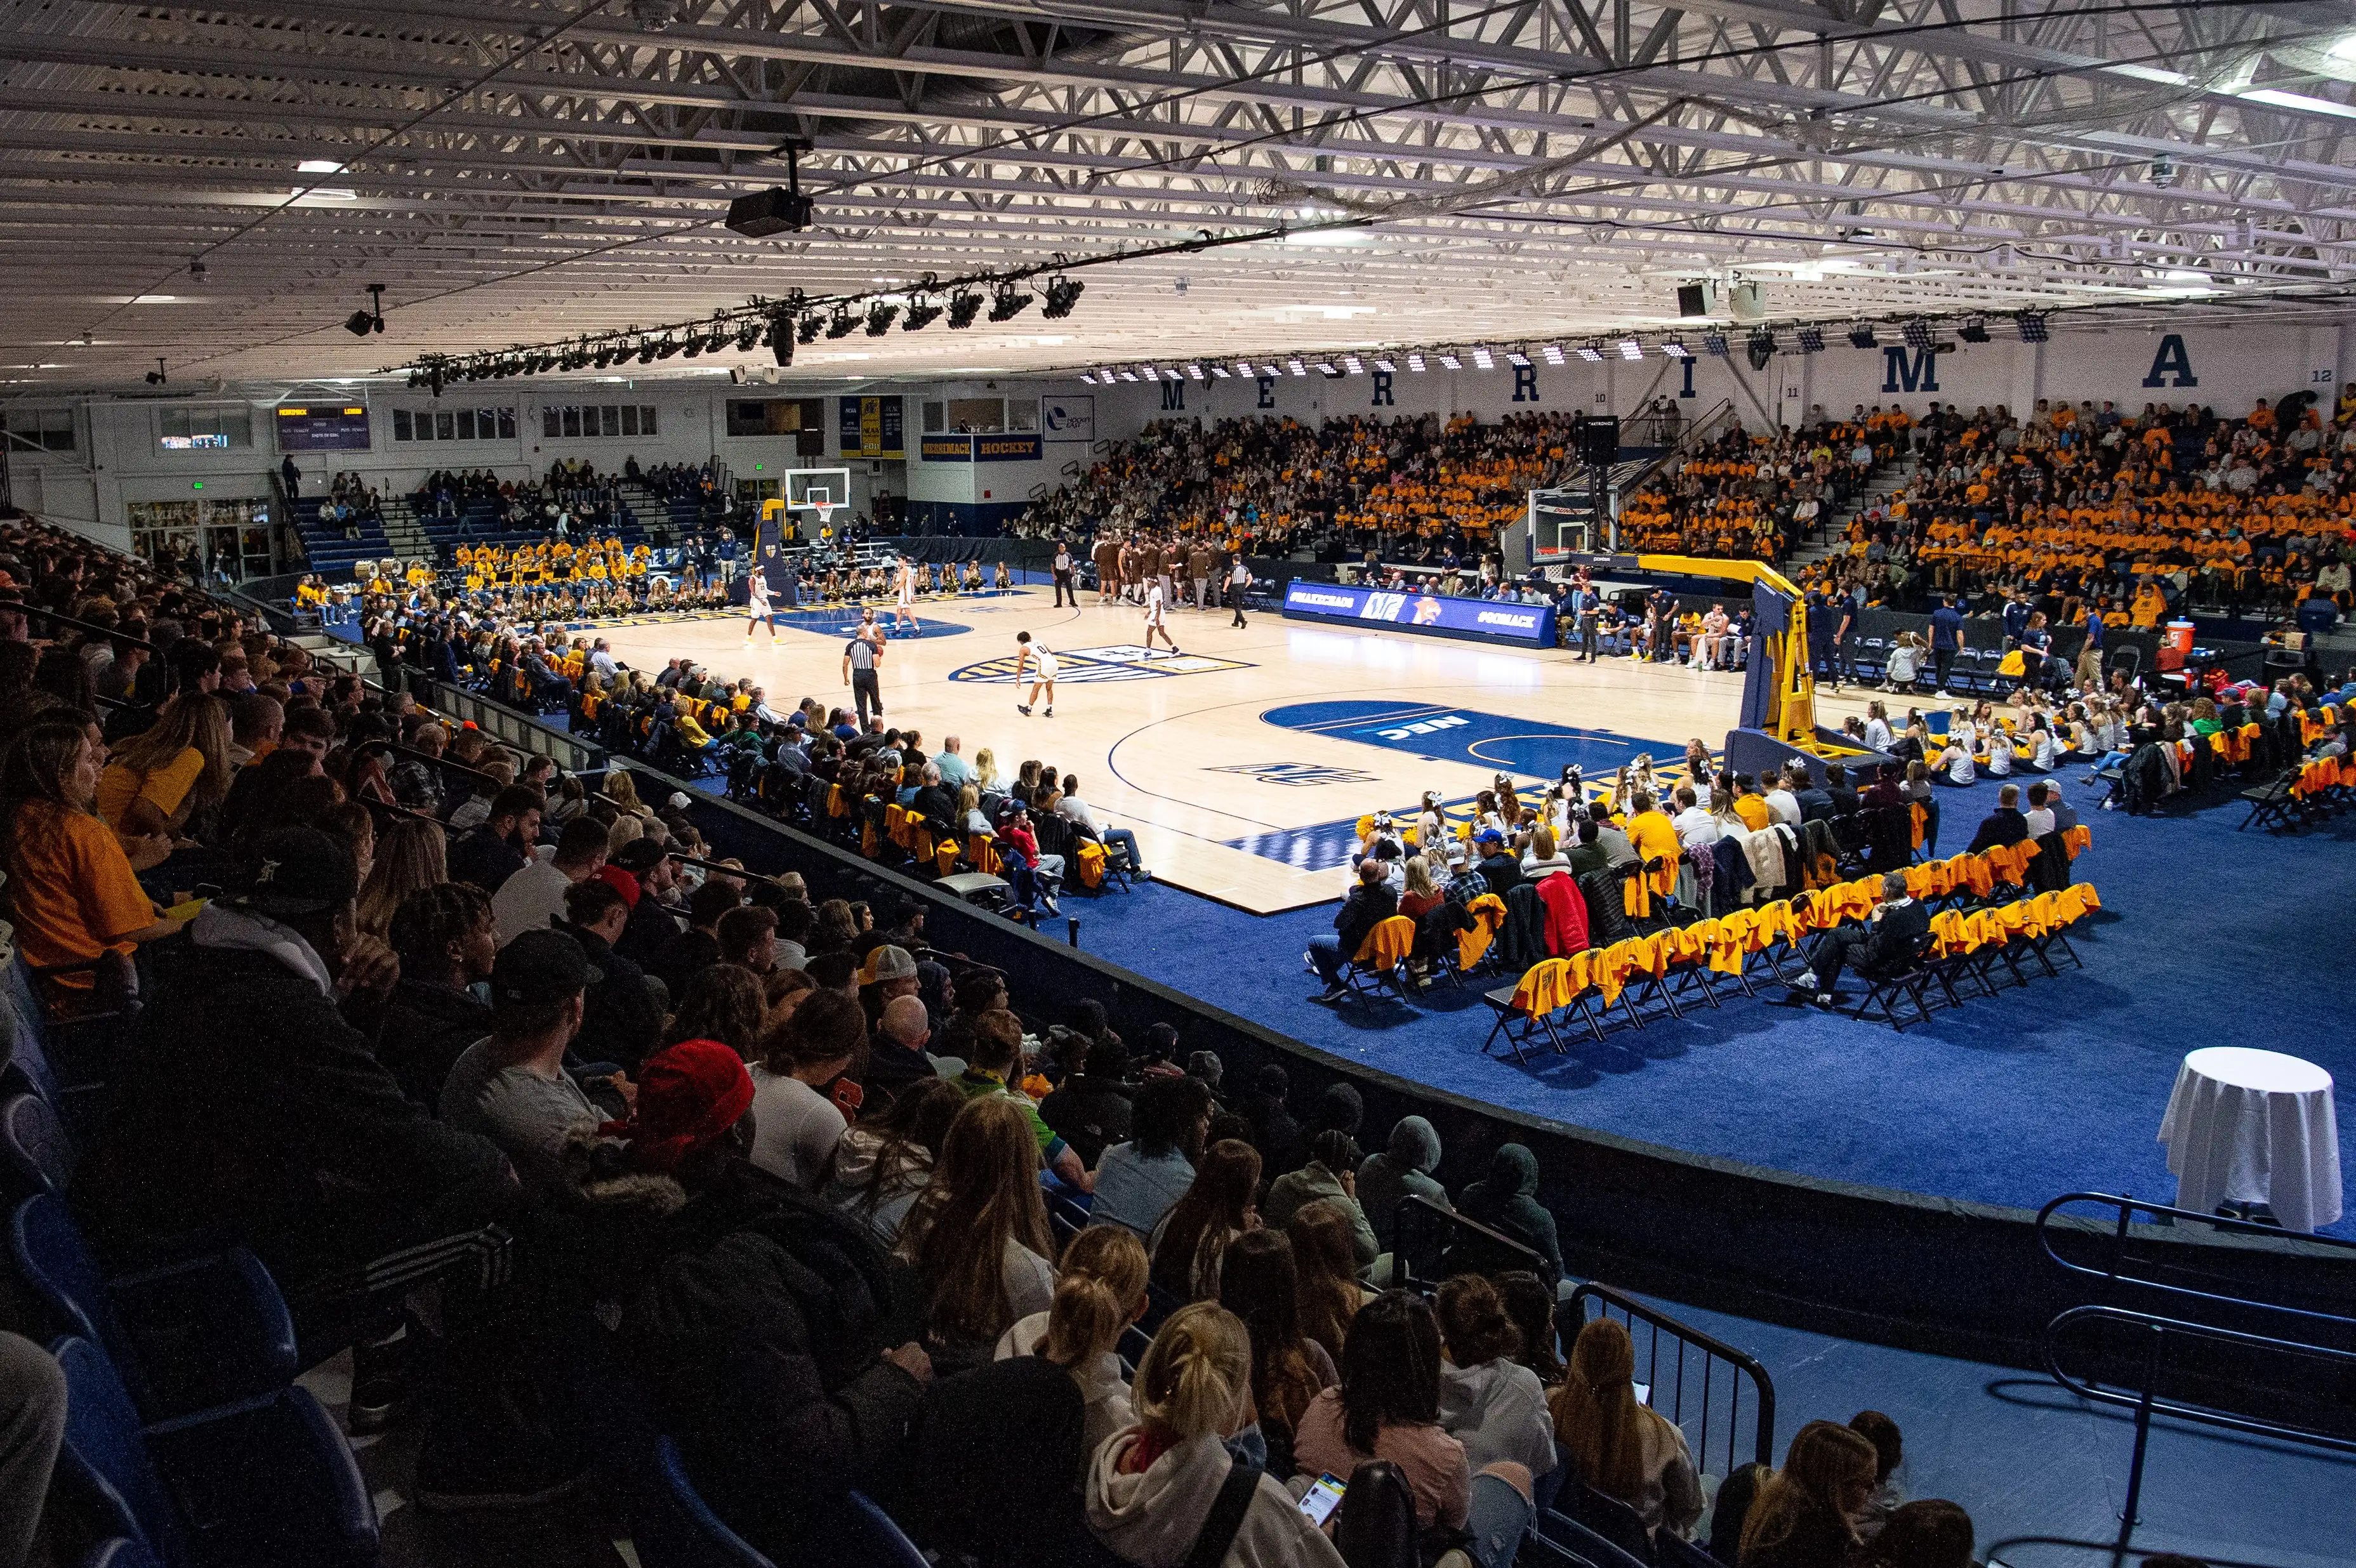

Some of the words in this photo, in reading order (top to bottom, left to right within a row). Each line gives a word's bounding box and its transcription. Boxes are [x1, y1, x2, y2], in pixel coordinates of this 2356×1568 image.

[1160, 379, 1185, 410] M
[1257, 376, 1274, 409] E
[1372, 371, 1394, 405] R
[1512, 364, 1540, 402] R
[1679, 356, 1697, 399] I
[1881, 346, 1940, 393] M
[2142, 334, 2198, 388] A
[2312, 369, 2332, 383] 12
[1595, 393, 1606, 403] 10
[1787, 388, 1799, 397] 11
[923, 443, 970, 455] MERRIMACK
[981, 442, 1035, 454] HOCKEY
[1478, 611, 1536, 628] #GOMACK
[1037, 645, 1047, 654] 0
[1376, 715, 1471, 741] NEC
